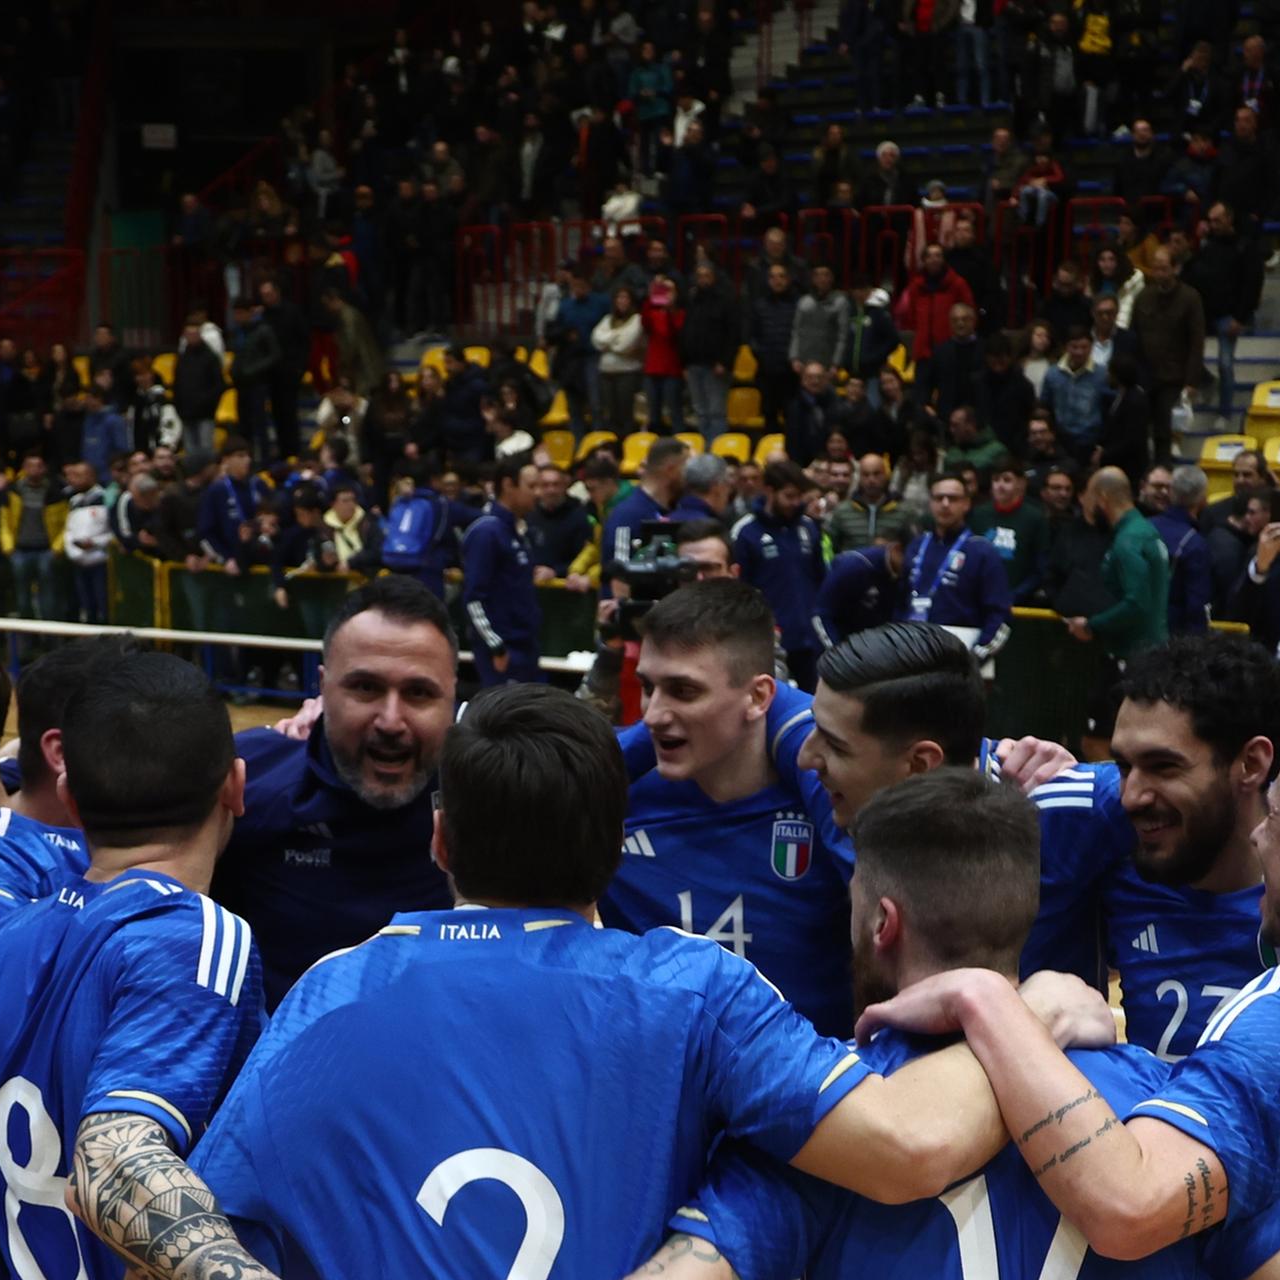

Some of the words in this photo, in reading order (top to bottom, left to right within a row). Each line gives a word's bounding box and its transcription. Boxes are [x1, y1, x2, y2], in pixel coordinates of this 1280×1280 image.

[776, 825, 809, 838] ITALIA
[440, 923, 501, 940] ITALIA
[677, 889, 753, 957] 14
[1155, 979, 1241, 1064] 27
